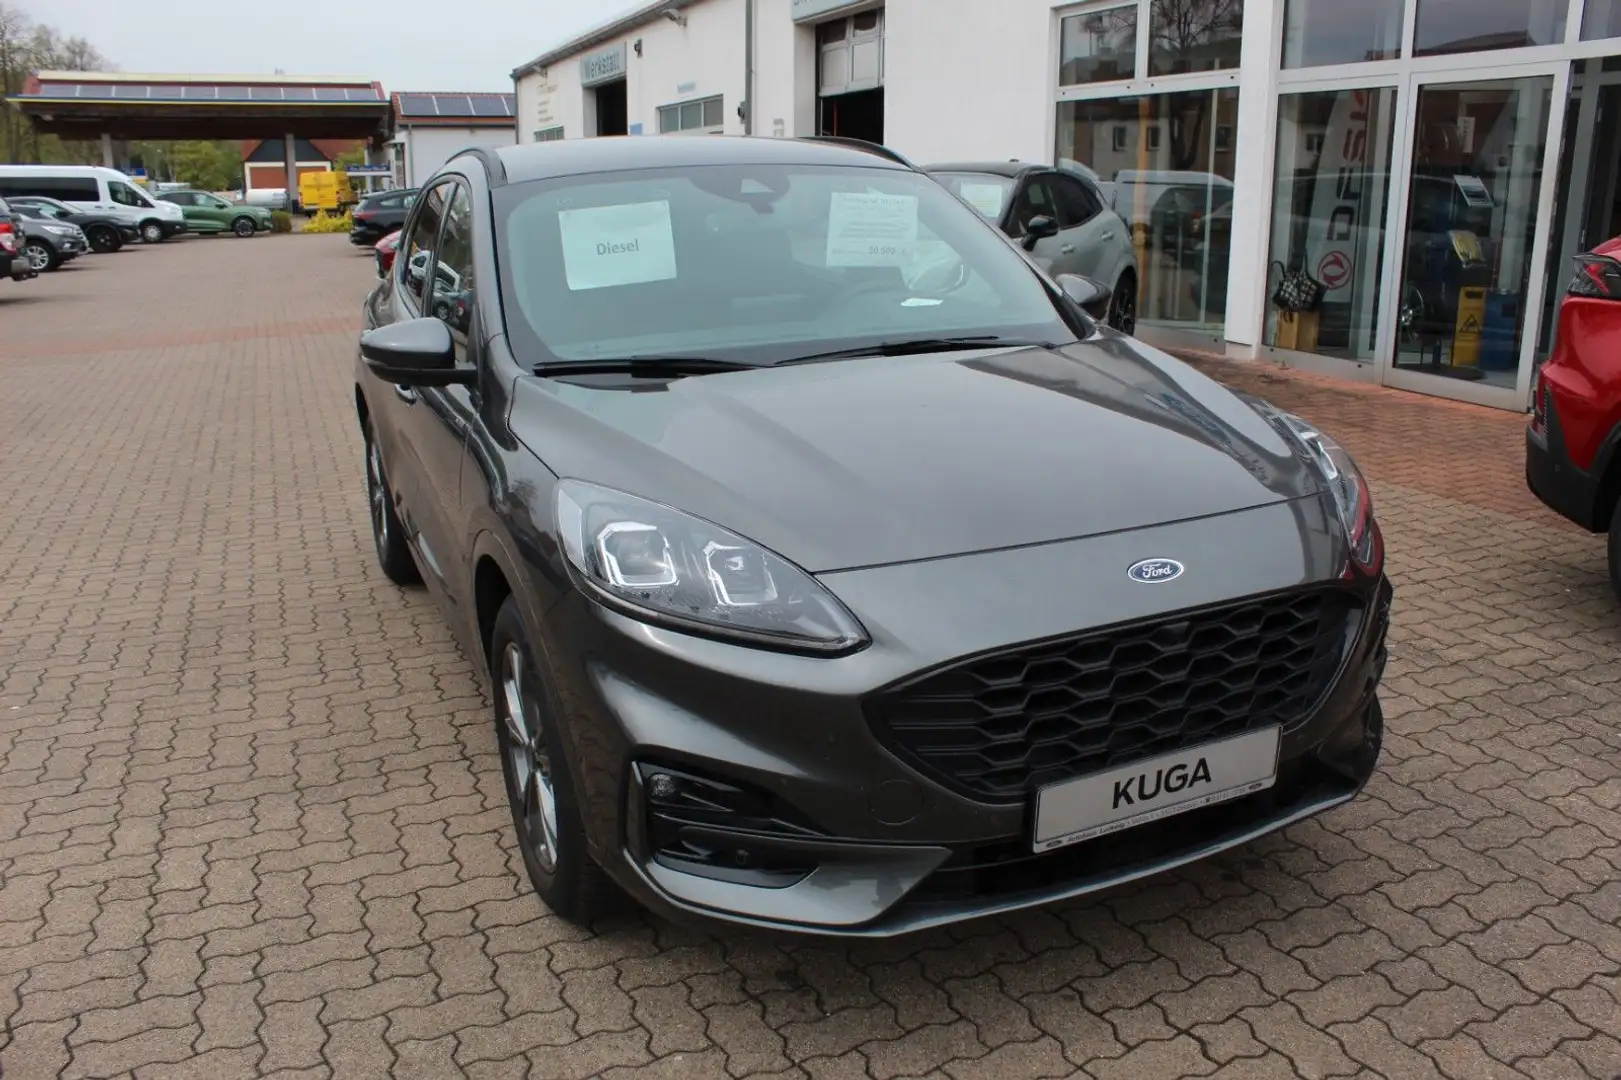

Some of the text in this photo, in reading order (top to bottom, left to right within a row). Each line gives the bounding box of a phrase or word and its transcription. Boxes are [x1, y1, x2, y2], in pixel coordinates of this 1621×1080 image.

[596, 239, 639, 256] Diesel
[1142, 563, 1172, 578] Ford
[1112, 757, 1212, 809] KUGA
